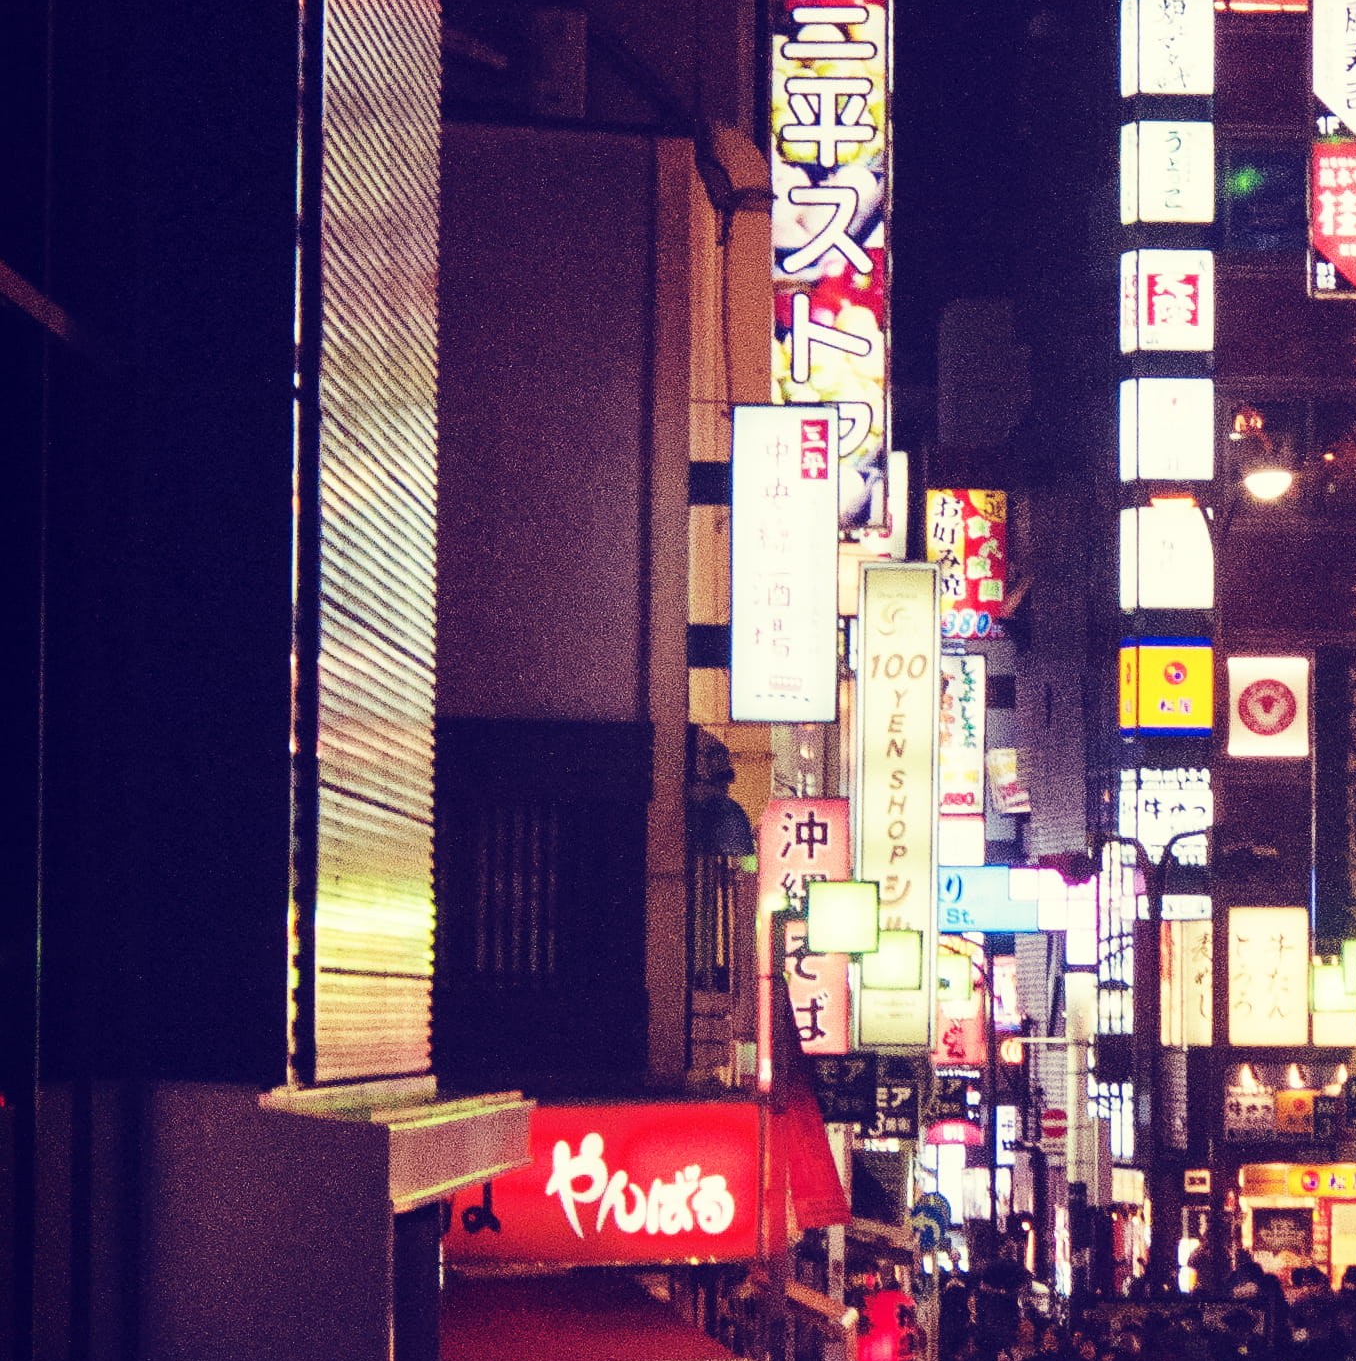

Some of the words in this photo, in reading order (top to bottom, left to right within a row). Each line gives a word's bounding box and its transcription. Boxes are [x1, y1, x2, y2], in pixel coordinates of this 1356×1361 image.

[1316, 115, 1340, 136] 1F
[802, 425, 827, 478] 三平
[870, 652, 928, 680] 100
[886, 688, 911, 759] YEN
[886, 770, 909, 866] SHOP
[546, 1132, 735, 1239] やんばる
